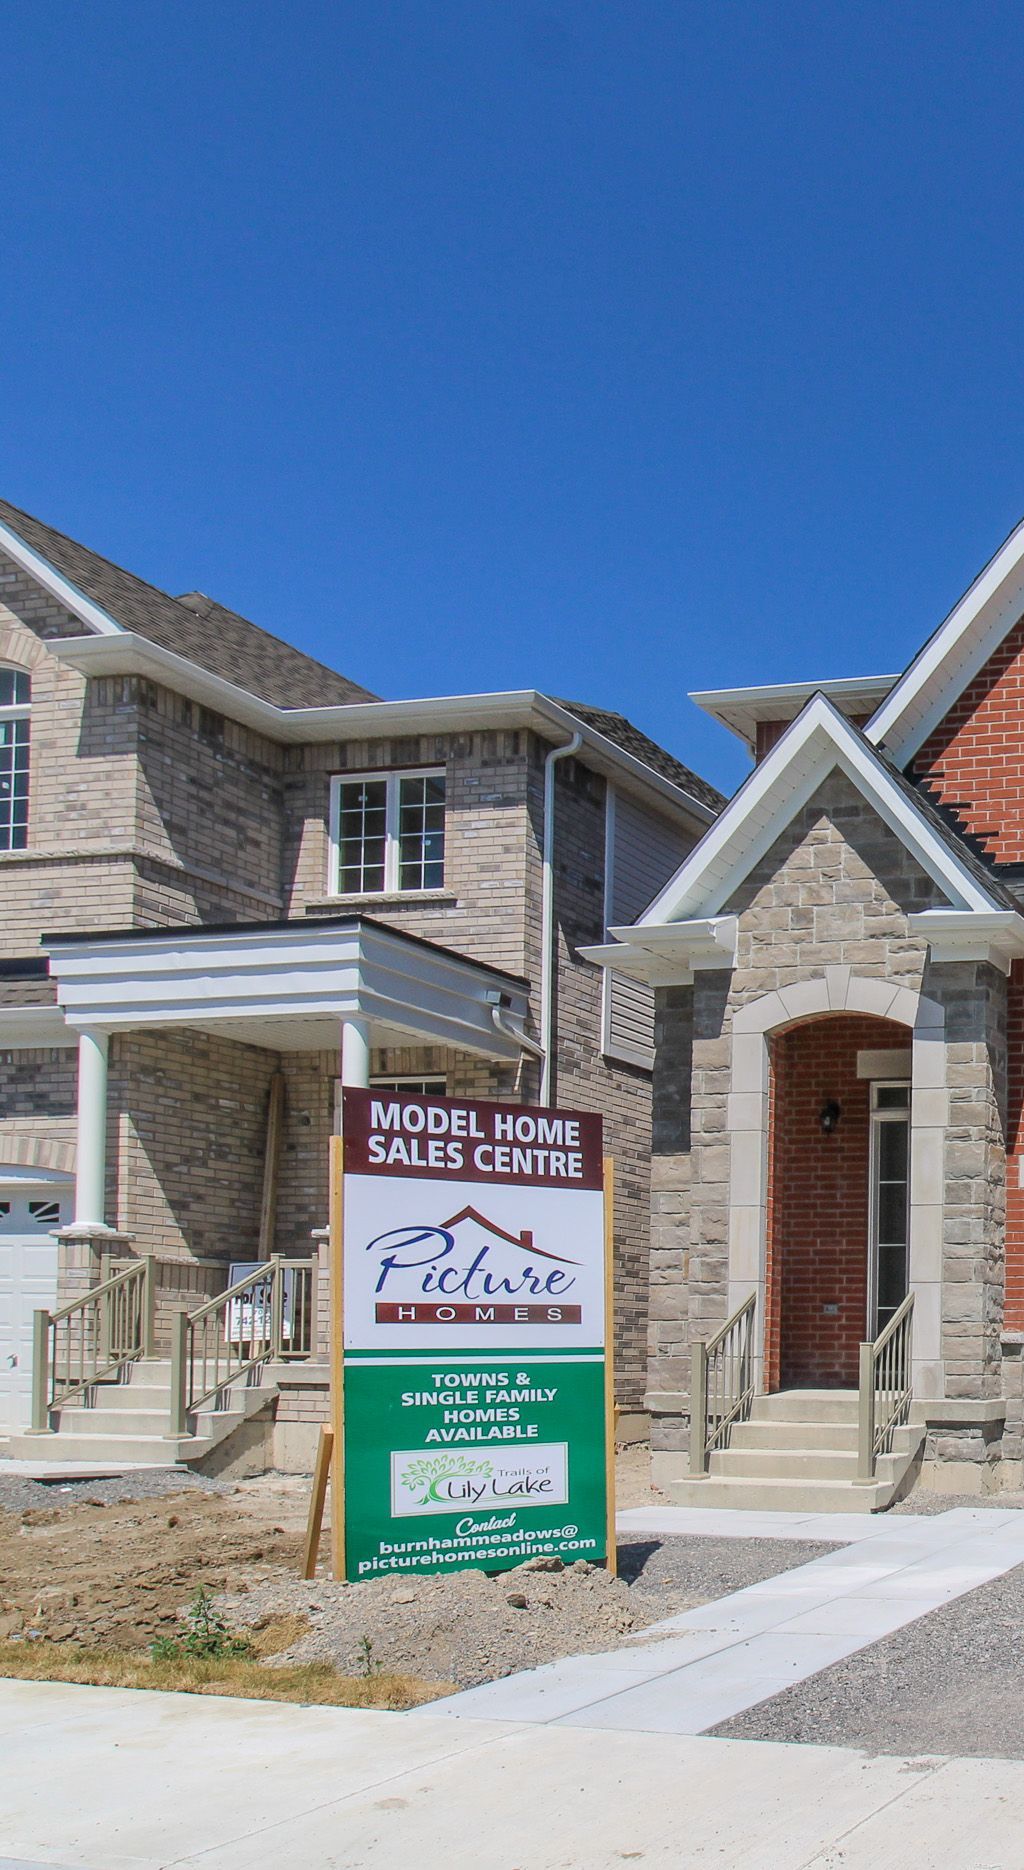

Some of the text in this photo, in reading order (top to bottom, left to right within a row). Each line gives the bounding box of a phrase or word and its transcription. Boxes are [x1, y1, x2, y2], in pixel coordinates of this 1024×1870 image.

[370, 1101, 580, 1147] MODEL HOME
[368, 1135, 583, 1179] SALES CENTRE
[366, 1225, 576, 1300] Picture
[398, 1306, 562, 1321] HOMES
[432, 1372, 531, 1388] TOWNS &
[401, 1388, 558, 1407] SINGLE FAMILY
[443, 1408, 520, 1424] HOMES
[425, 1424, 538, 1443] AVAILABLE
[497, 1466, 550, 1478] Trails of
[447, 1476, 554, 1503] Lily Lake
[455, 1512, 517, 1537] Contact
[379, 1524, 578, 1555] burnhammeadows@
[358, 1538, 596, 1574] picturehomesonline.com
